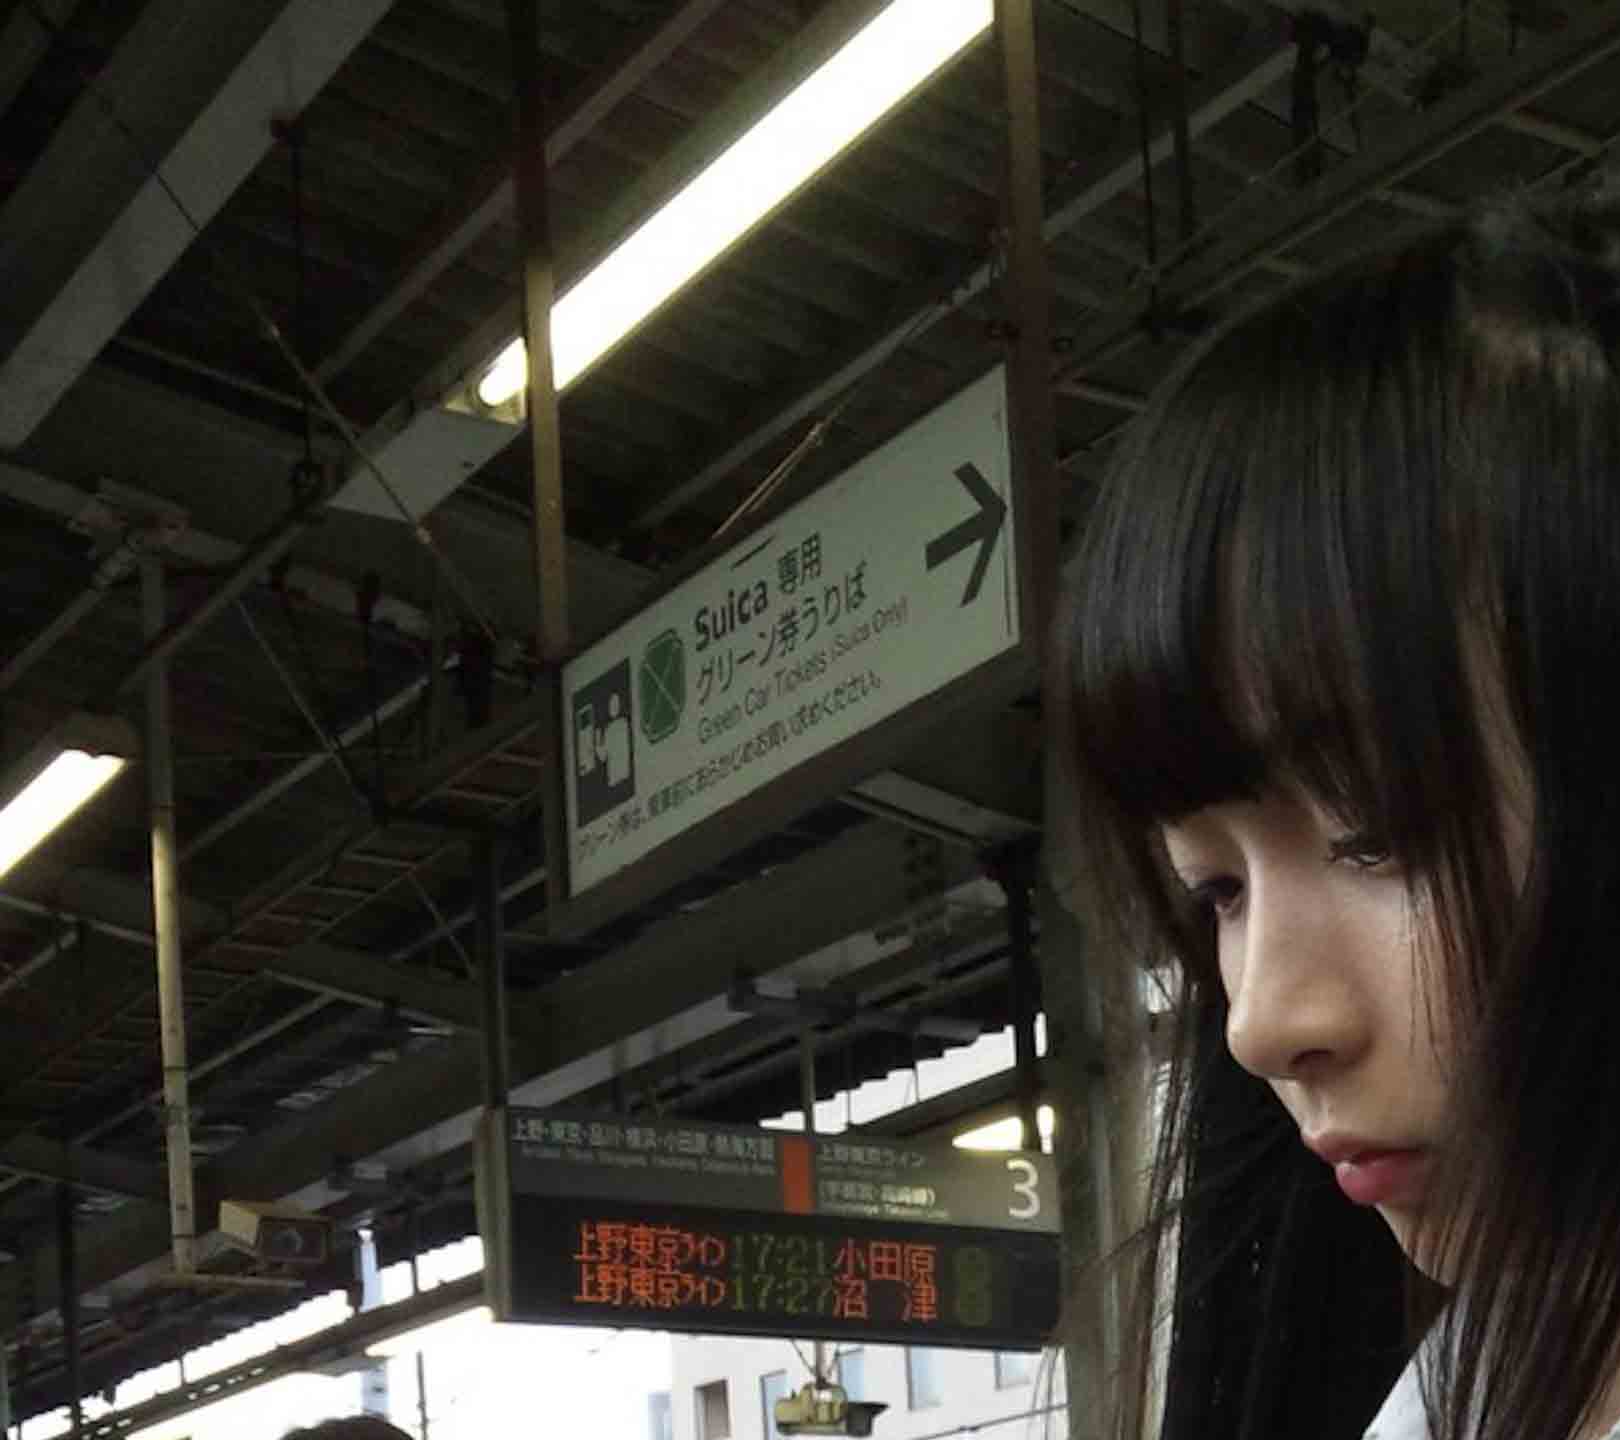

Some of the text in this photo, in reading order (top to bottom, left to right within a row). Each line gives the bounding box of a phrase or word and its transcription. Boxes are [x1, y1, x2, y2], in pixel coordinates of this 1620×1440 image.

[695, 531, 823, 652] Suica 専用
[698, 560, 869, 704] グリーン券うりば
[699, 705, 742, 744] Green
[745, 684, 772, 718] Car
[776, 652, 827, 697] Tickets
[1006, 1159, 1041, 1219] 3
[732, 1233, 827, 1276] 17:21
[833, 1237, 938, 1281] 小田原
[732, 1275, 834, 1314] 17:27
